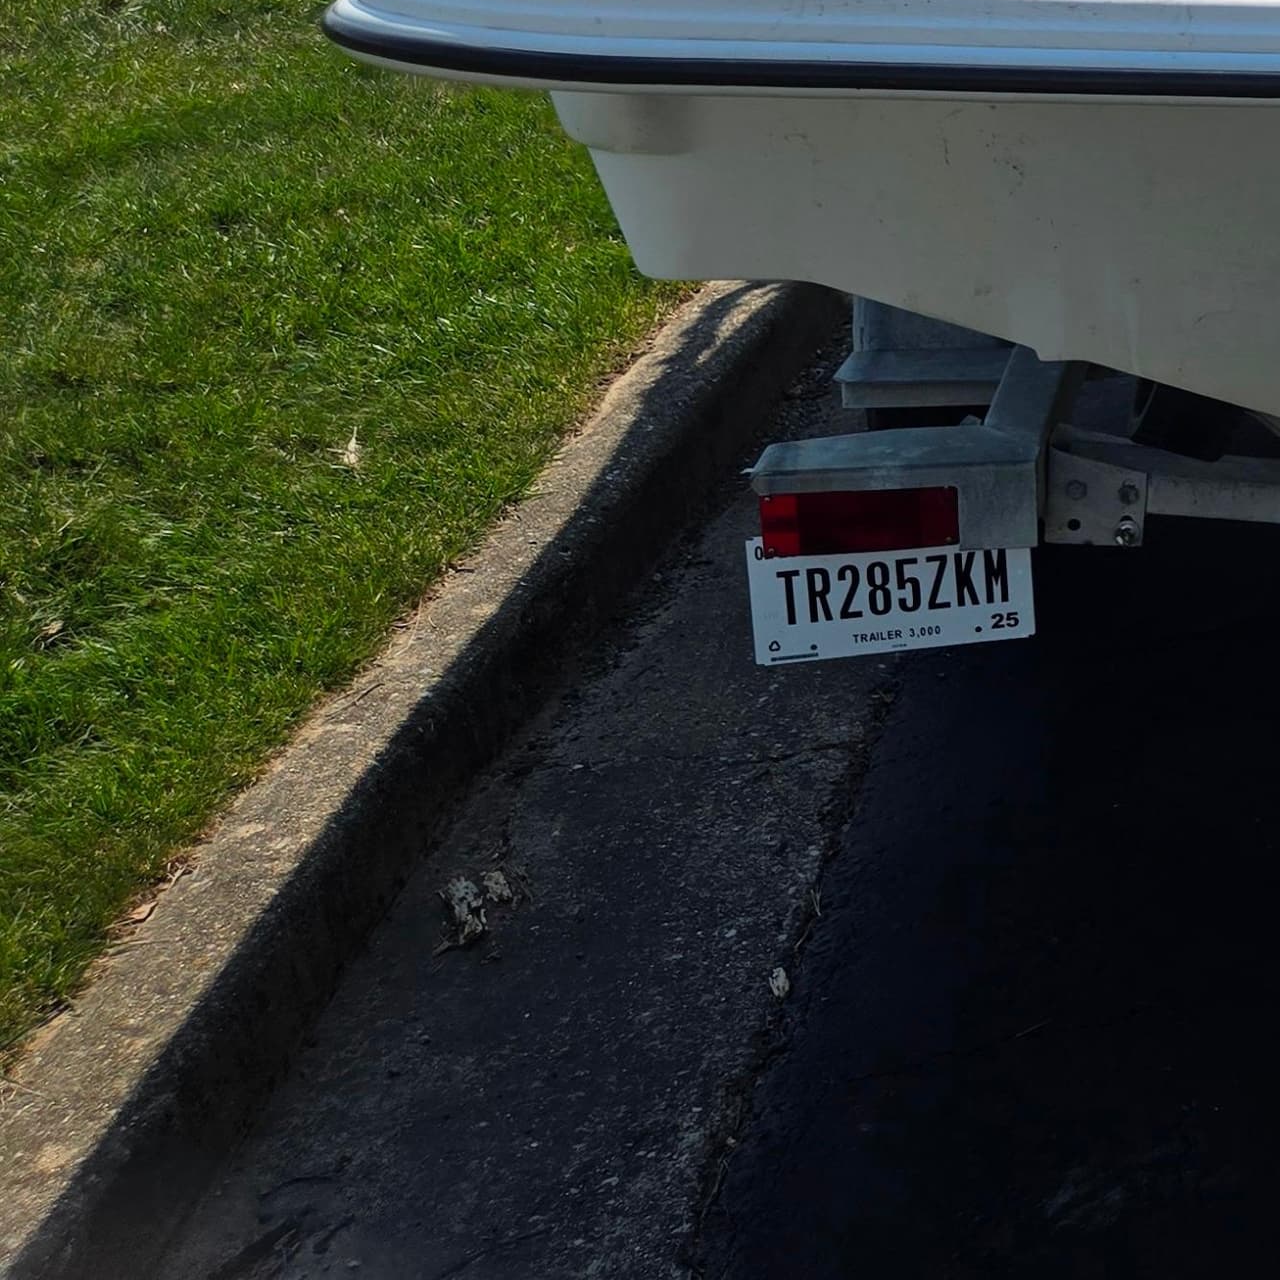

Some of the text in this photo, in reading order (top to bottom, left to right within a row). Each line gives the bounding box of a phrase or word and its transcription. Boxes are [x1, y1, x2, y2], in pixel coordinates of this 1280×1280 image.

[776, 548, 1010, 626] TR285ZKM
[990, 612, 1020, 630] 25
[852, 625, 941, 644] TRAILER 3,000
